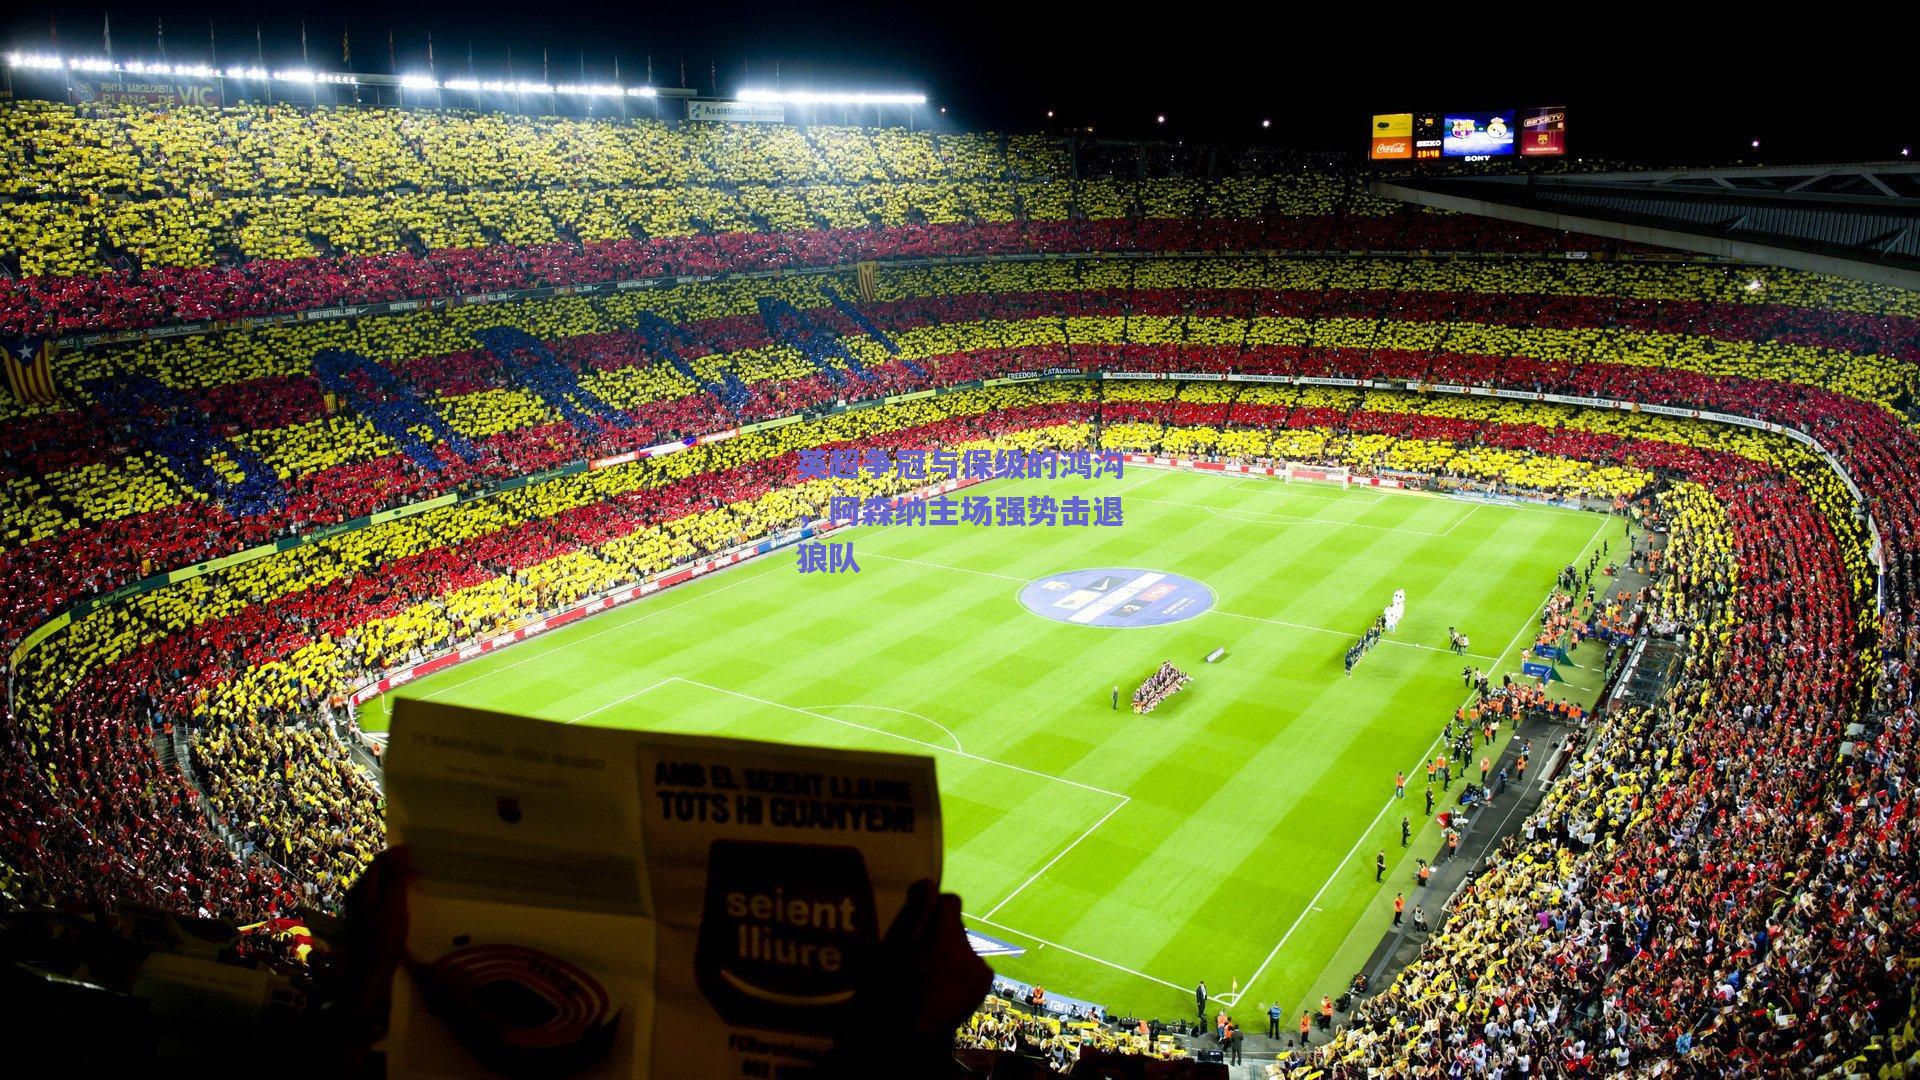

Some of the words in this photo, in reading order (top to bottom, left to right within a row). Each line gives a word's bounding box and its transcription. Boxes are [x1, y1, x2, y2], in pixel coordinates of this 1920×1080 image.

[177, 85, 214, 106] VIC
[307, 307, 357, 320] NIKEFOOTBALL.COM
[1007, 371, 1038, 380] FREEDOM
[1043, 368, 1081, 376] CATALONIA
[655, 761, 705, 788] AMB
[711, 765, 737, 791] EL
[743, 768, 825, 798] SEIENT
[657, 790, 730, 823] TOTS
[735, 795, 764, 826] HI
[725, 883, 857, 934] seient
[736, 922, 845, 974] lliure
